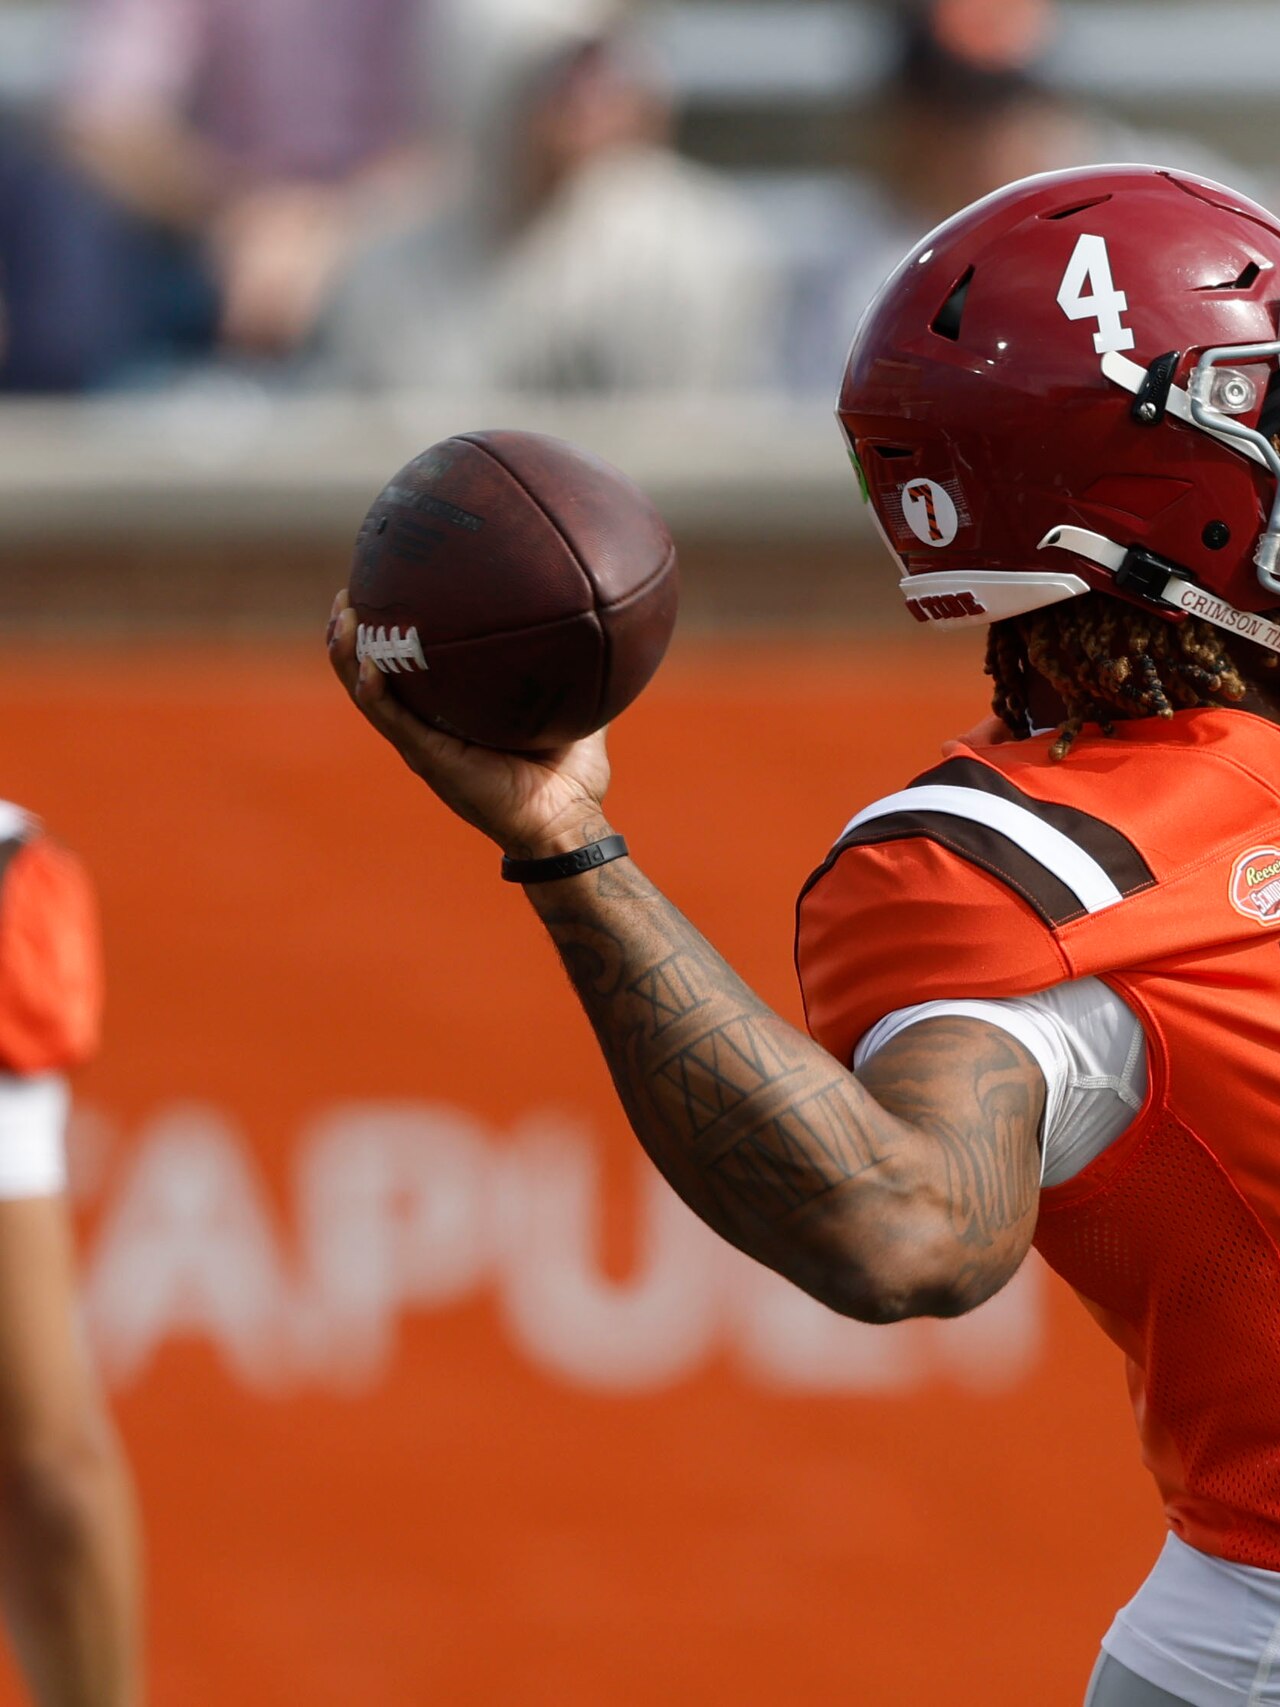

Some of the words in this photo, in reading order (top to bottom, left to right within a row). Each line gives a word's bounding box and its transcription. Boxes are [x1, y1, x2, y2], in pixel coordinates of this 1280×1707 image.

[1056, 233, 1135, 354] 4
[907, 484, 944, 541] 7
[1181, 591, 1263, 636] CRIMSON
